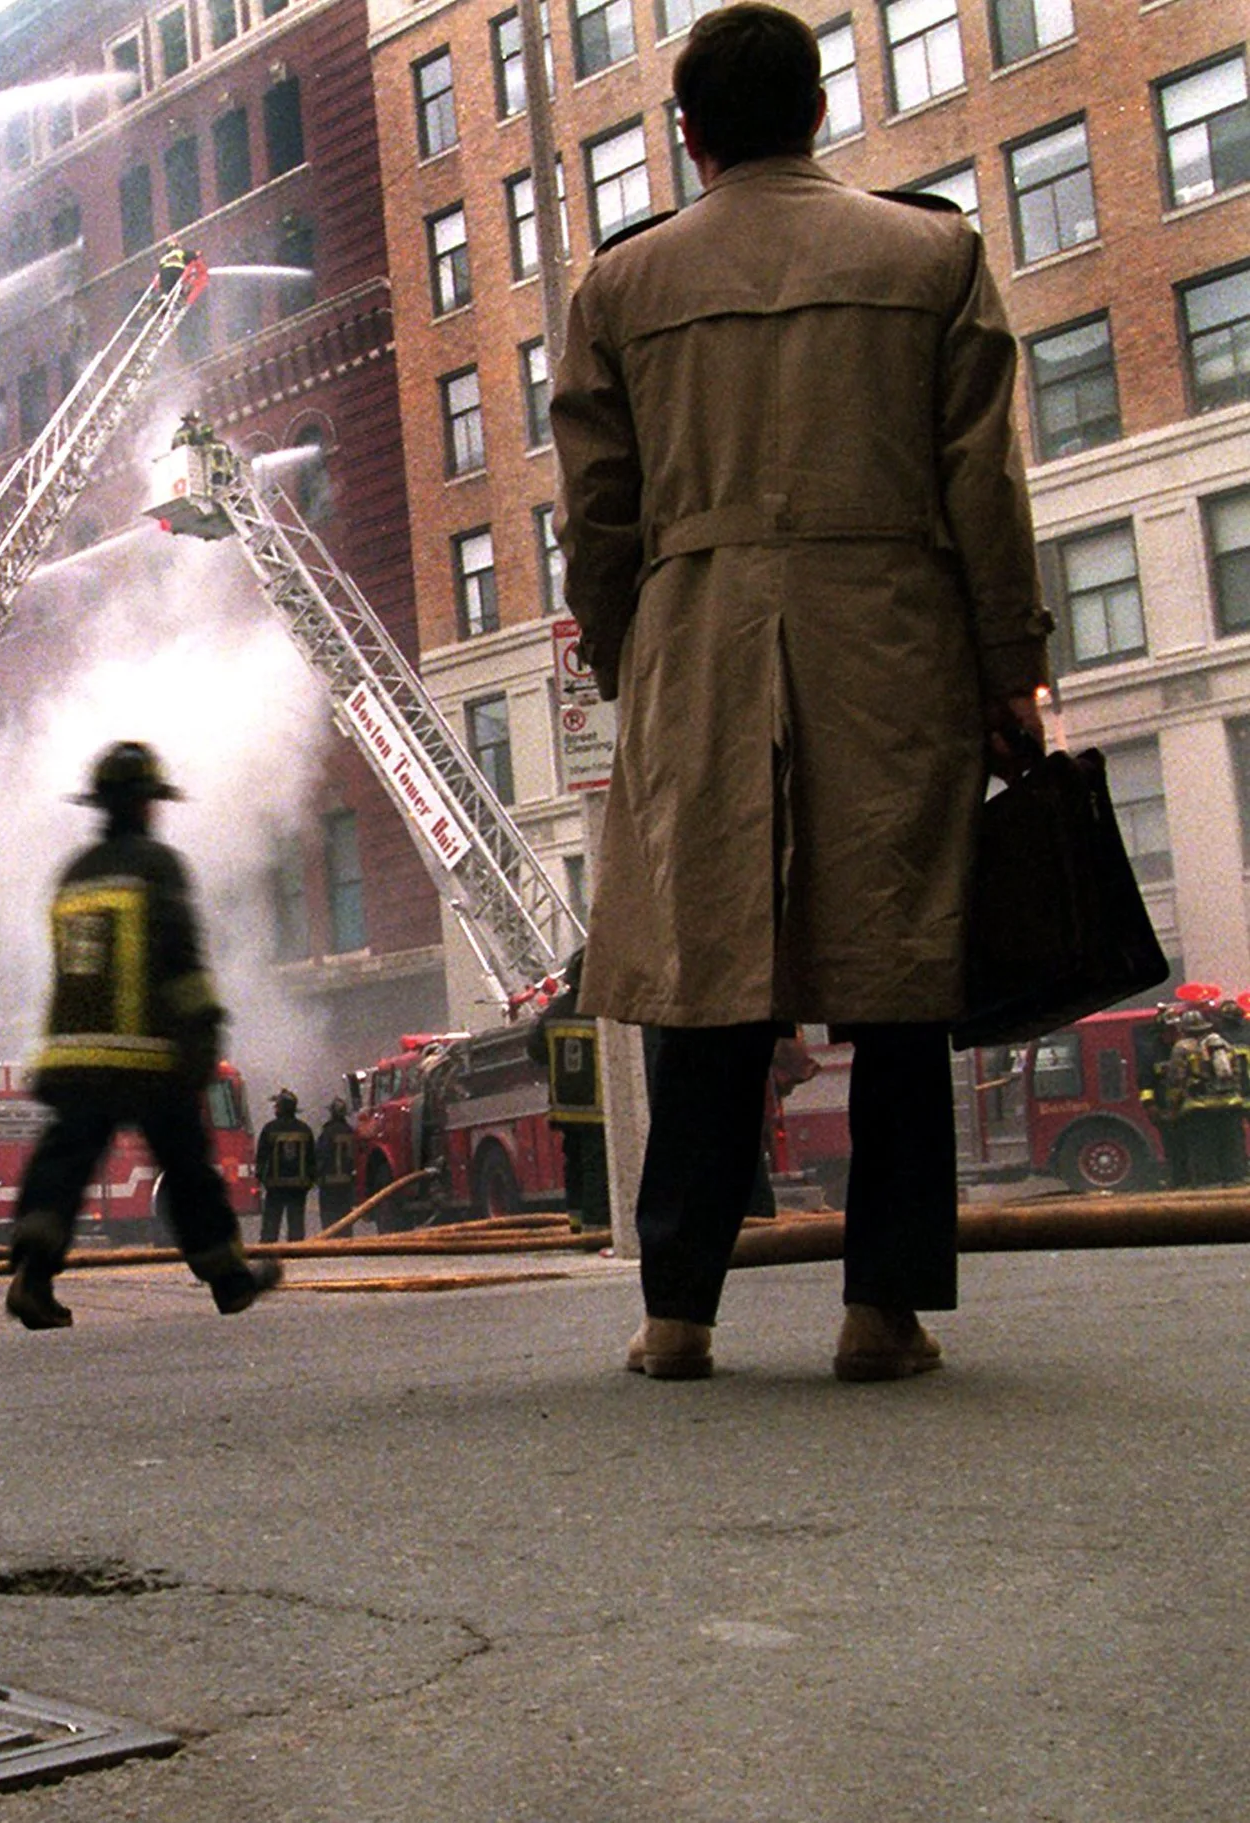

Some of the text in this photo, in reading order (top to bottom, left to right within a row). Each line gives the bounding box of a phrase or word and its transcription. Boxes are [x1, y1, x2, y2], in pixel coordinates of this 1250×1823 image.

[351, 691, 460, 859] Boston Tower Unit
